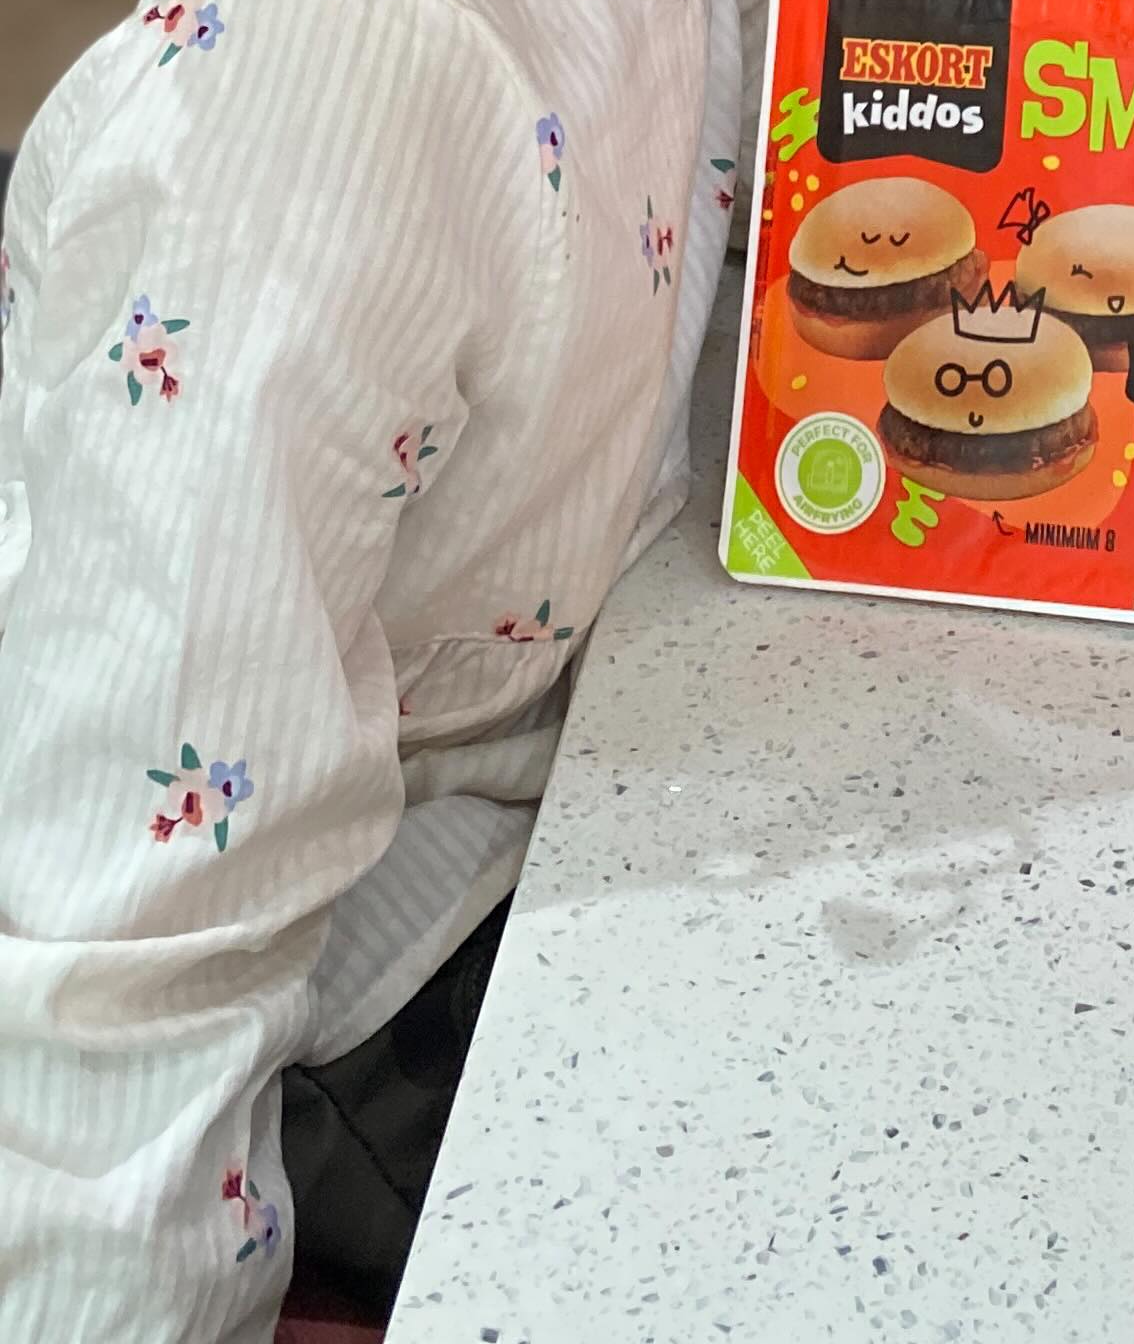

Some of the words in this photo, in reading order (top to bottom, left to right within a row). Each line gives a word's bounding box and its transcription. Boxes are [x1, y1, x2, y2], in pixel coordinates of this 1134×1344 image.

[840, 37, 993, 89] ESKORT
[843, 89, 984, 135] kiddos
[792, 424, 848, 456] PERFECT
[850, 435, 872, 464] FOR
[794, 495, 863, 523] AIRFRYING
[735, 520, 775, 574] HERE
[749, 510, 786, 559] PEEL
[1025, 521, 1100, 550] MINIMUM
[1105, 529, 1115, 552] 8
